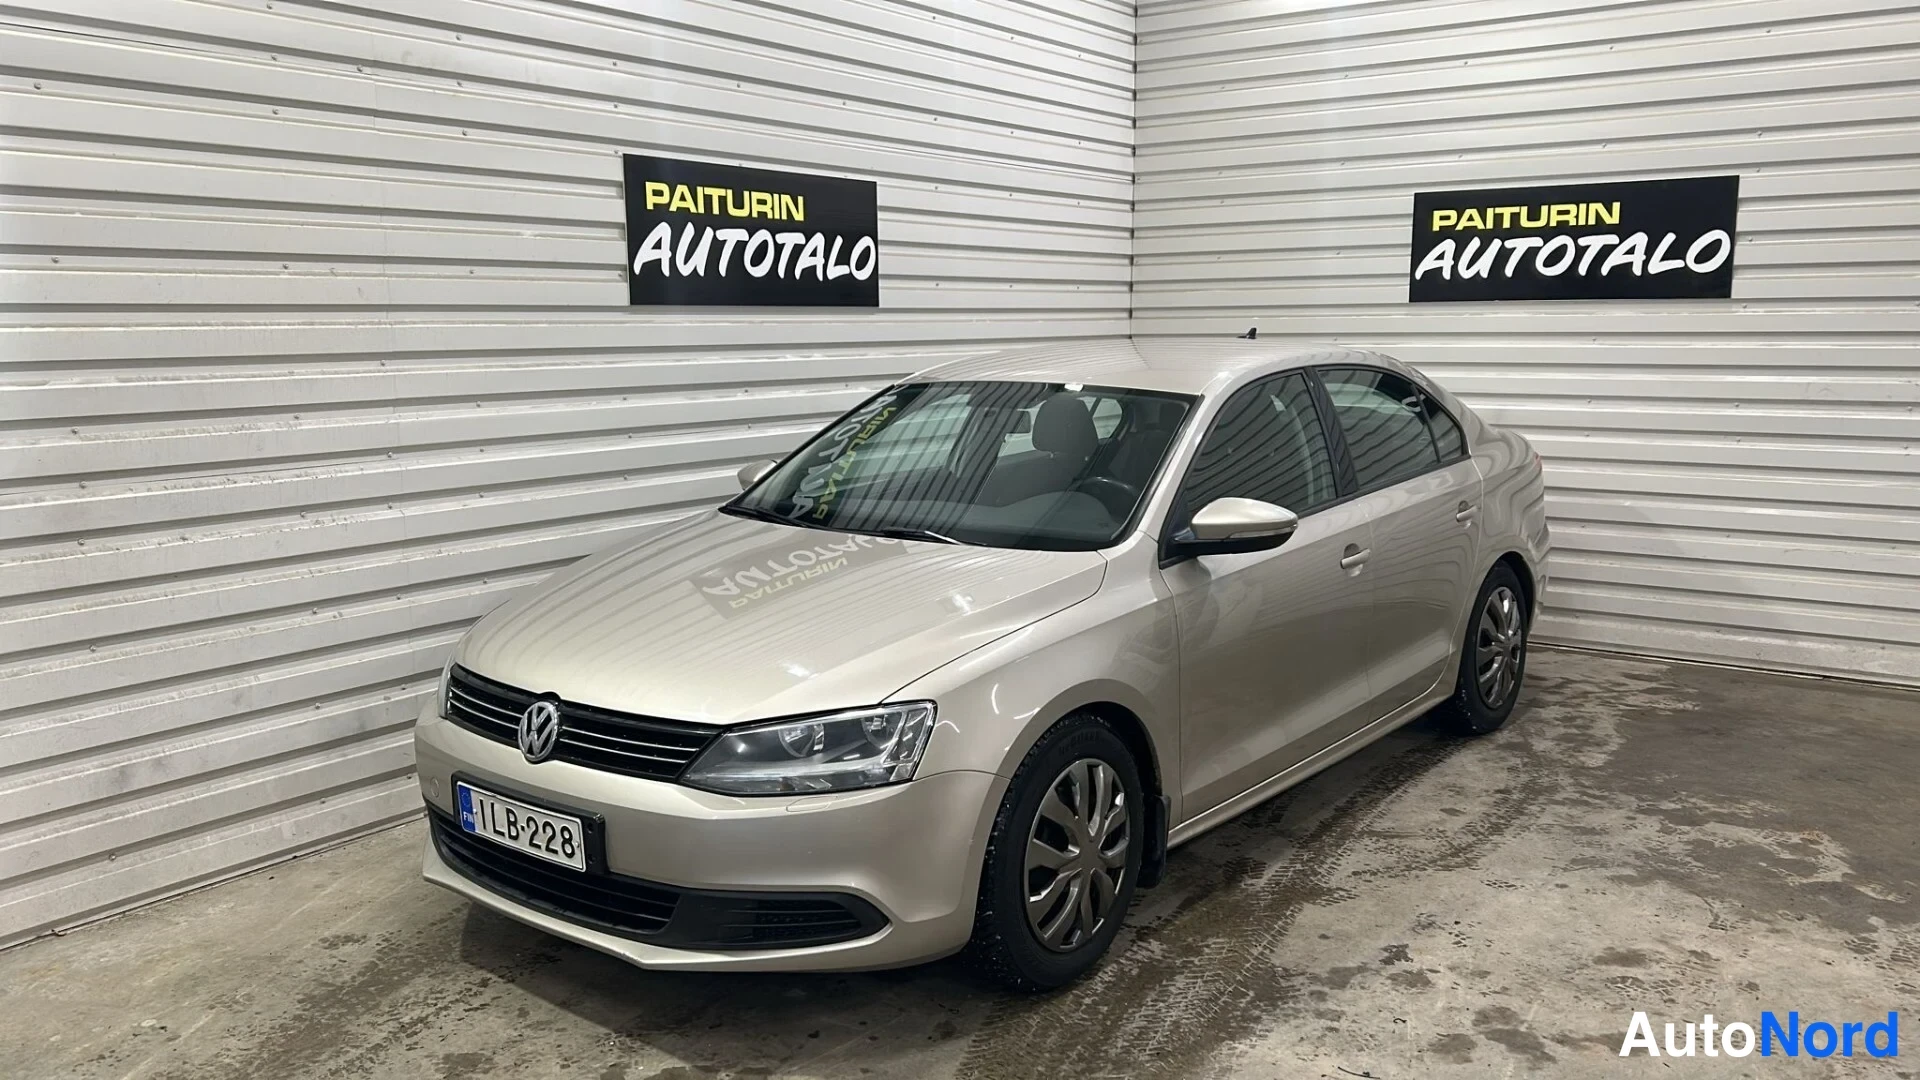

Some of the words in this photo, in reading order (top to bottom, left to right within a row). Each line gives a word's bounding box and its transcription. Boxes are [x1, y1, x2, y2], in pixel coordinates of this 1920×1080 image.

[645, 181, 805, 222] PAITURIN
[1432, 201, 1621, 232] PAITURIN
[633, 221, 876, 281] AUTOTALO
[1415, 229, 1731, 280] AUTOTALO
[463, 811, 474, 823] FIN
